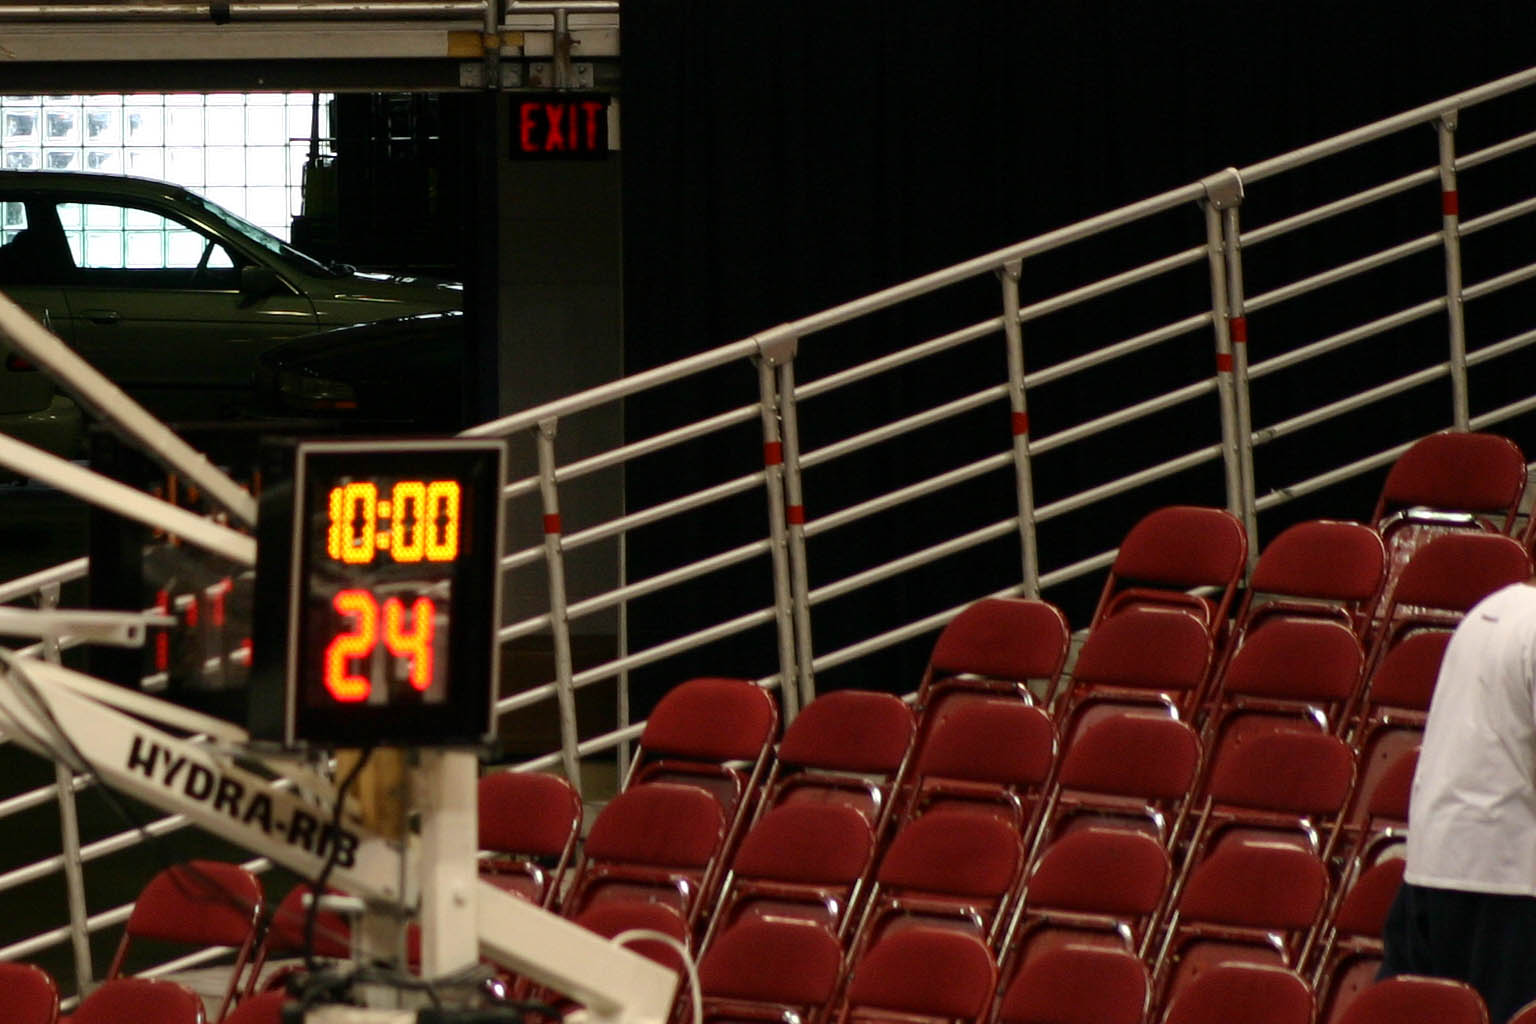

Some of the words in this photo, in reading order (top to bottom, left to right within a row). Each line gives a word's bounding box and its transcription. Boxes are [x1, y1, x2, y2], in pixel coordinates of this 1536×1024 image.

[520, 101, 603, 152] EXIT
[328, 481, 460, 563] 10:00
[324, 589, 435, 702] 24
[127, 736, 359, 869] HYDRA-RIB
